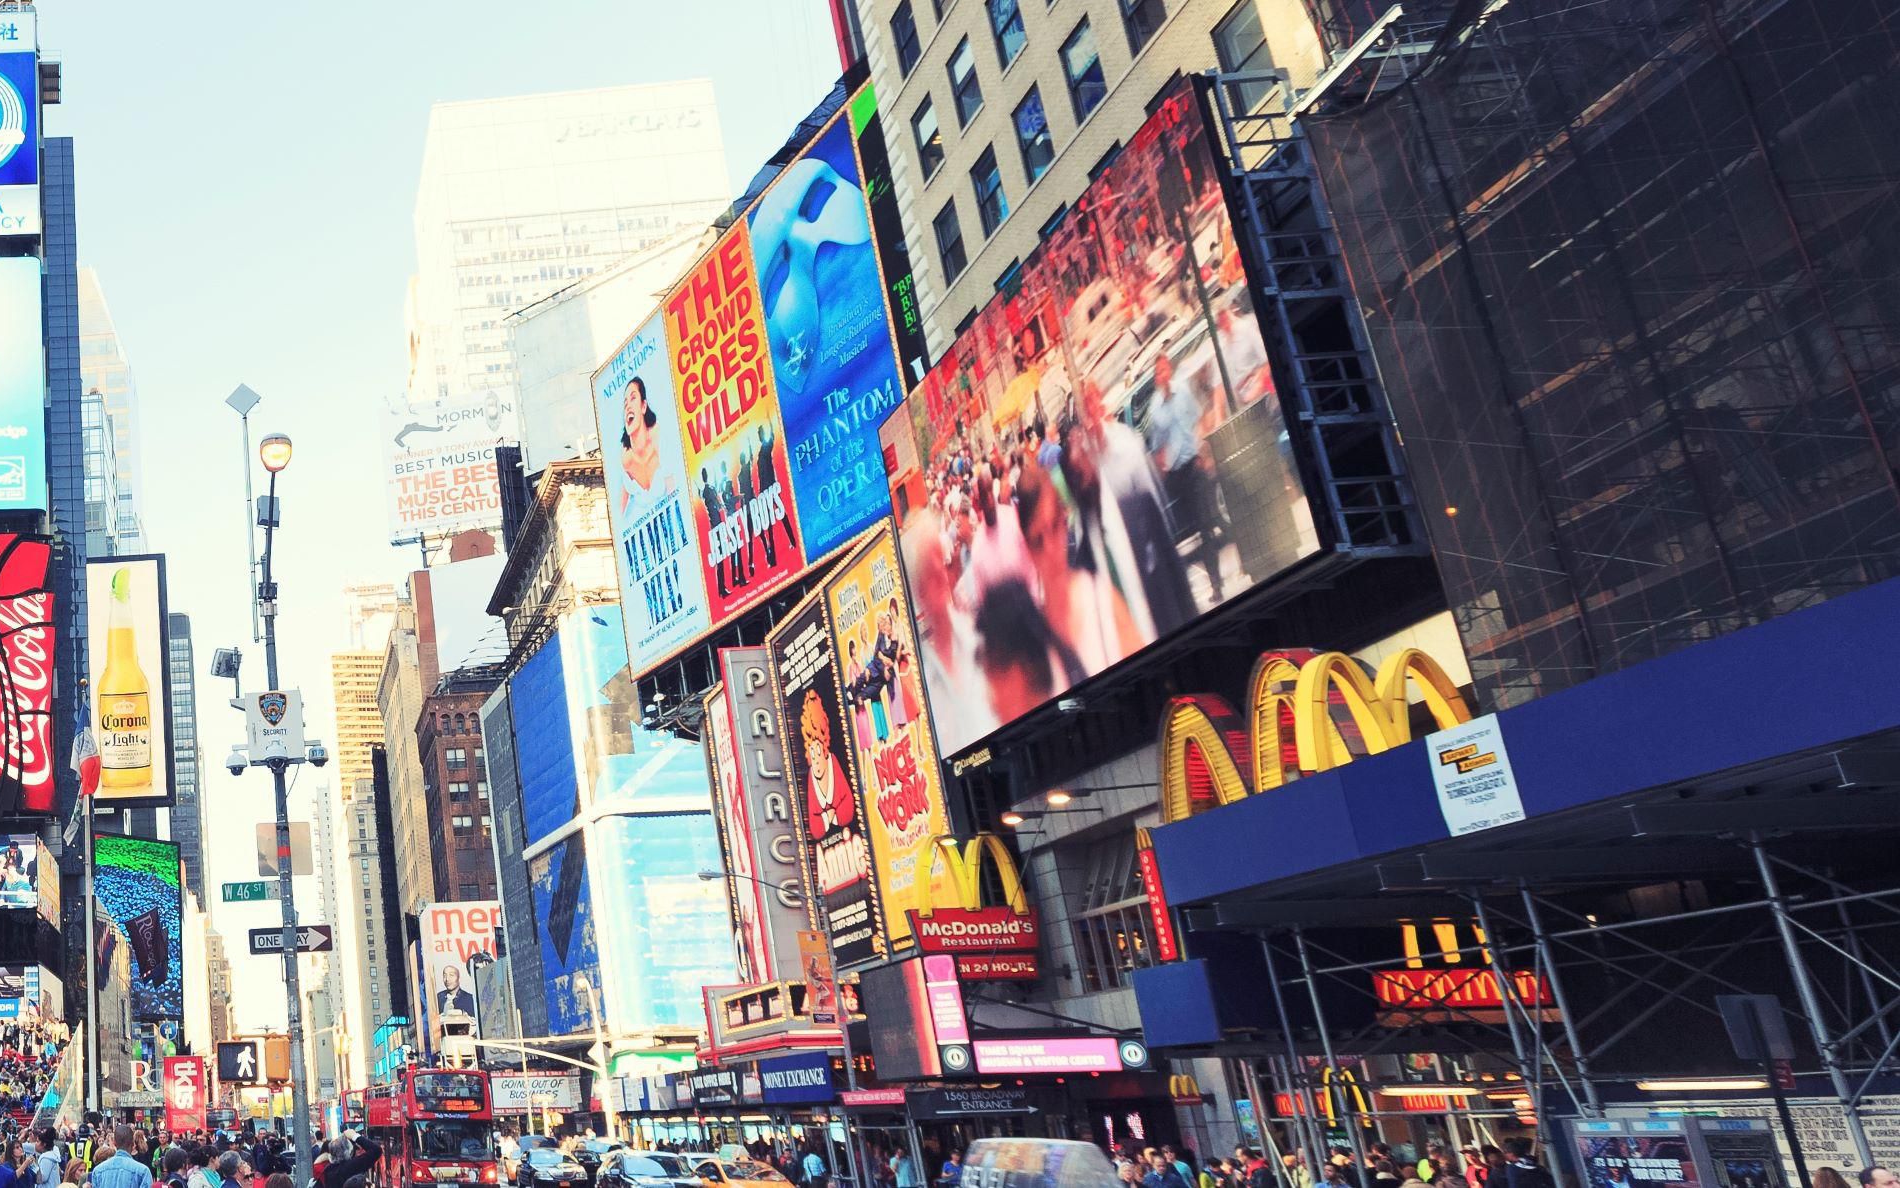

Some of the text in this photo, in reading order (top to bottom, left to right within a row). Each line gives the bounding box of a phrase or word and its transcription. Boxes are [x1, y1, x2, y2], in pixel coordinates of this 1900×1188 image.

[669, 230, 749, 343] THE
[676, 286, 753, 376] CROWD
[603, 337, 657, 400] NEVER STOPS!
[610, 333, 644, 375] THE FUN
[681, 318, 761, 414] GOES
[837, 334, 869, 370] Musical
[822, 385, 852, 417] The
[794, 377, 897, 474] PHANTOM
[394, 458, 435, 475] BEST
[828, 436, 866, 474] of the
[397, 483, 489, 511] MUSICAL
[817, 451, 886, 513] OPERA
[399, 506, 437, 523] THIS
[707, 503, 751, 569] JERSEY
[748, 481, 786, 538] BOYS
[624, 499, 689, 588] MAMMA
[643, 558, 683, 631] MIA!
[101, 714, 148, 733] Corona
[111, 733, 140, 747] Light
[262, 728, 288, 736] SECURITY
[873, 733, 918, 793] NICE
[744, 665, 803, 910] PALACE
[877, 772, 930, 832] WORK
[816, 827, 867, 893] Annie
[224, 882, 263, 900] W 46 ST
[257, 934, 281, 948] ONE
[434, 937, 452, 953] at
[921, 920, 1034, 937] McDonald's
[941, 935, 1017, 948] Restaurant
[974, 963, 989, 974] 24
[173, 1060, 198, 1111] tkts
[550, 1078, 565, 1089] OF
[762, 1067, 827, 1089] MONEY EXCHANGE
[944, 1089, 1027, 1101] 1560 BROADWAY
[961, 1099, 1013, 1111] ENTRANCE
